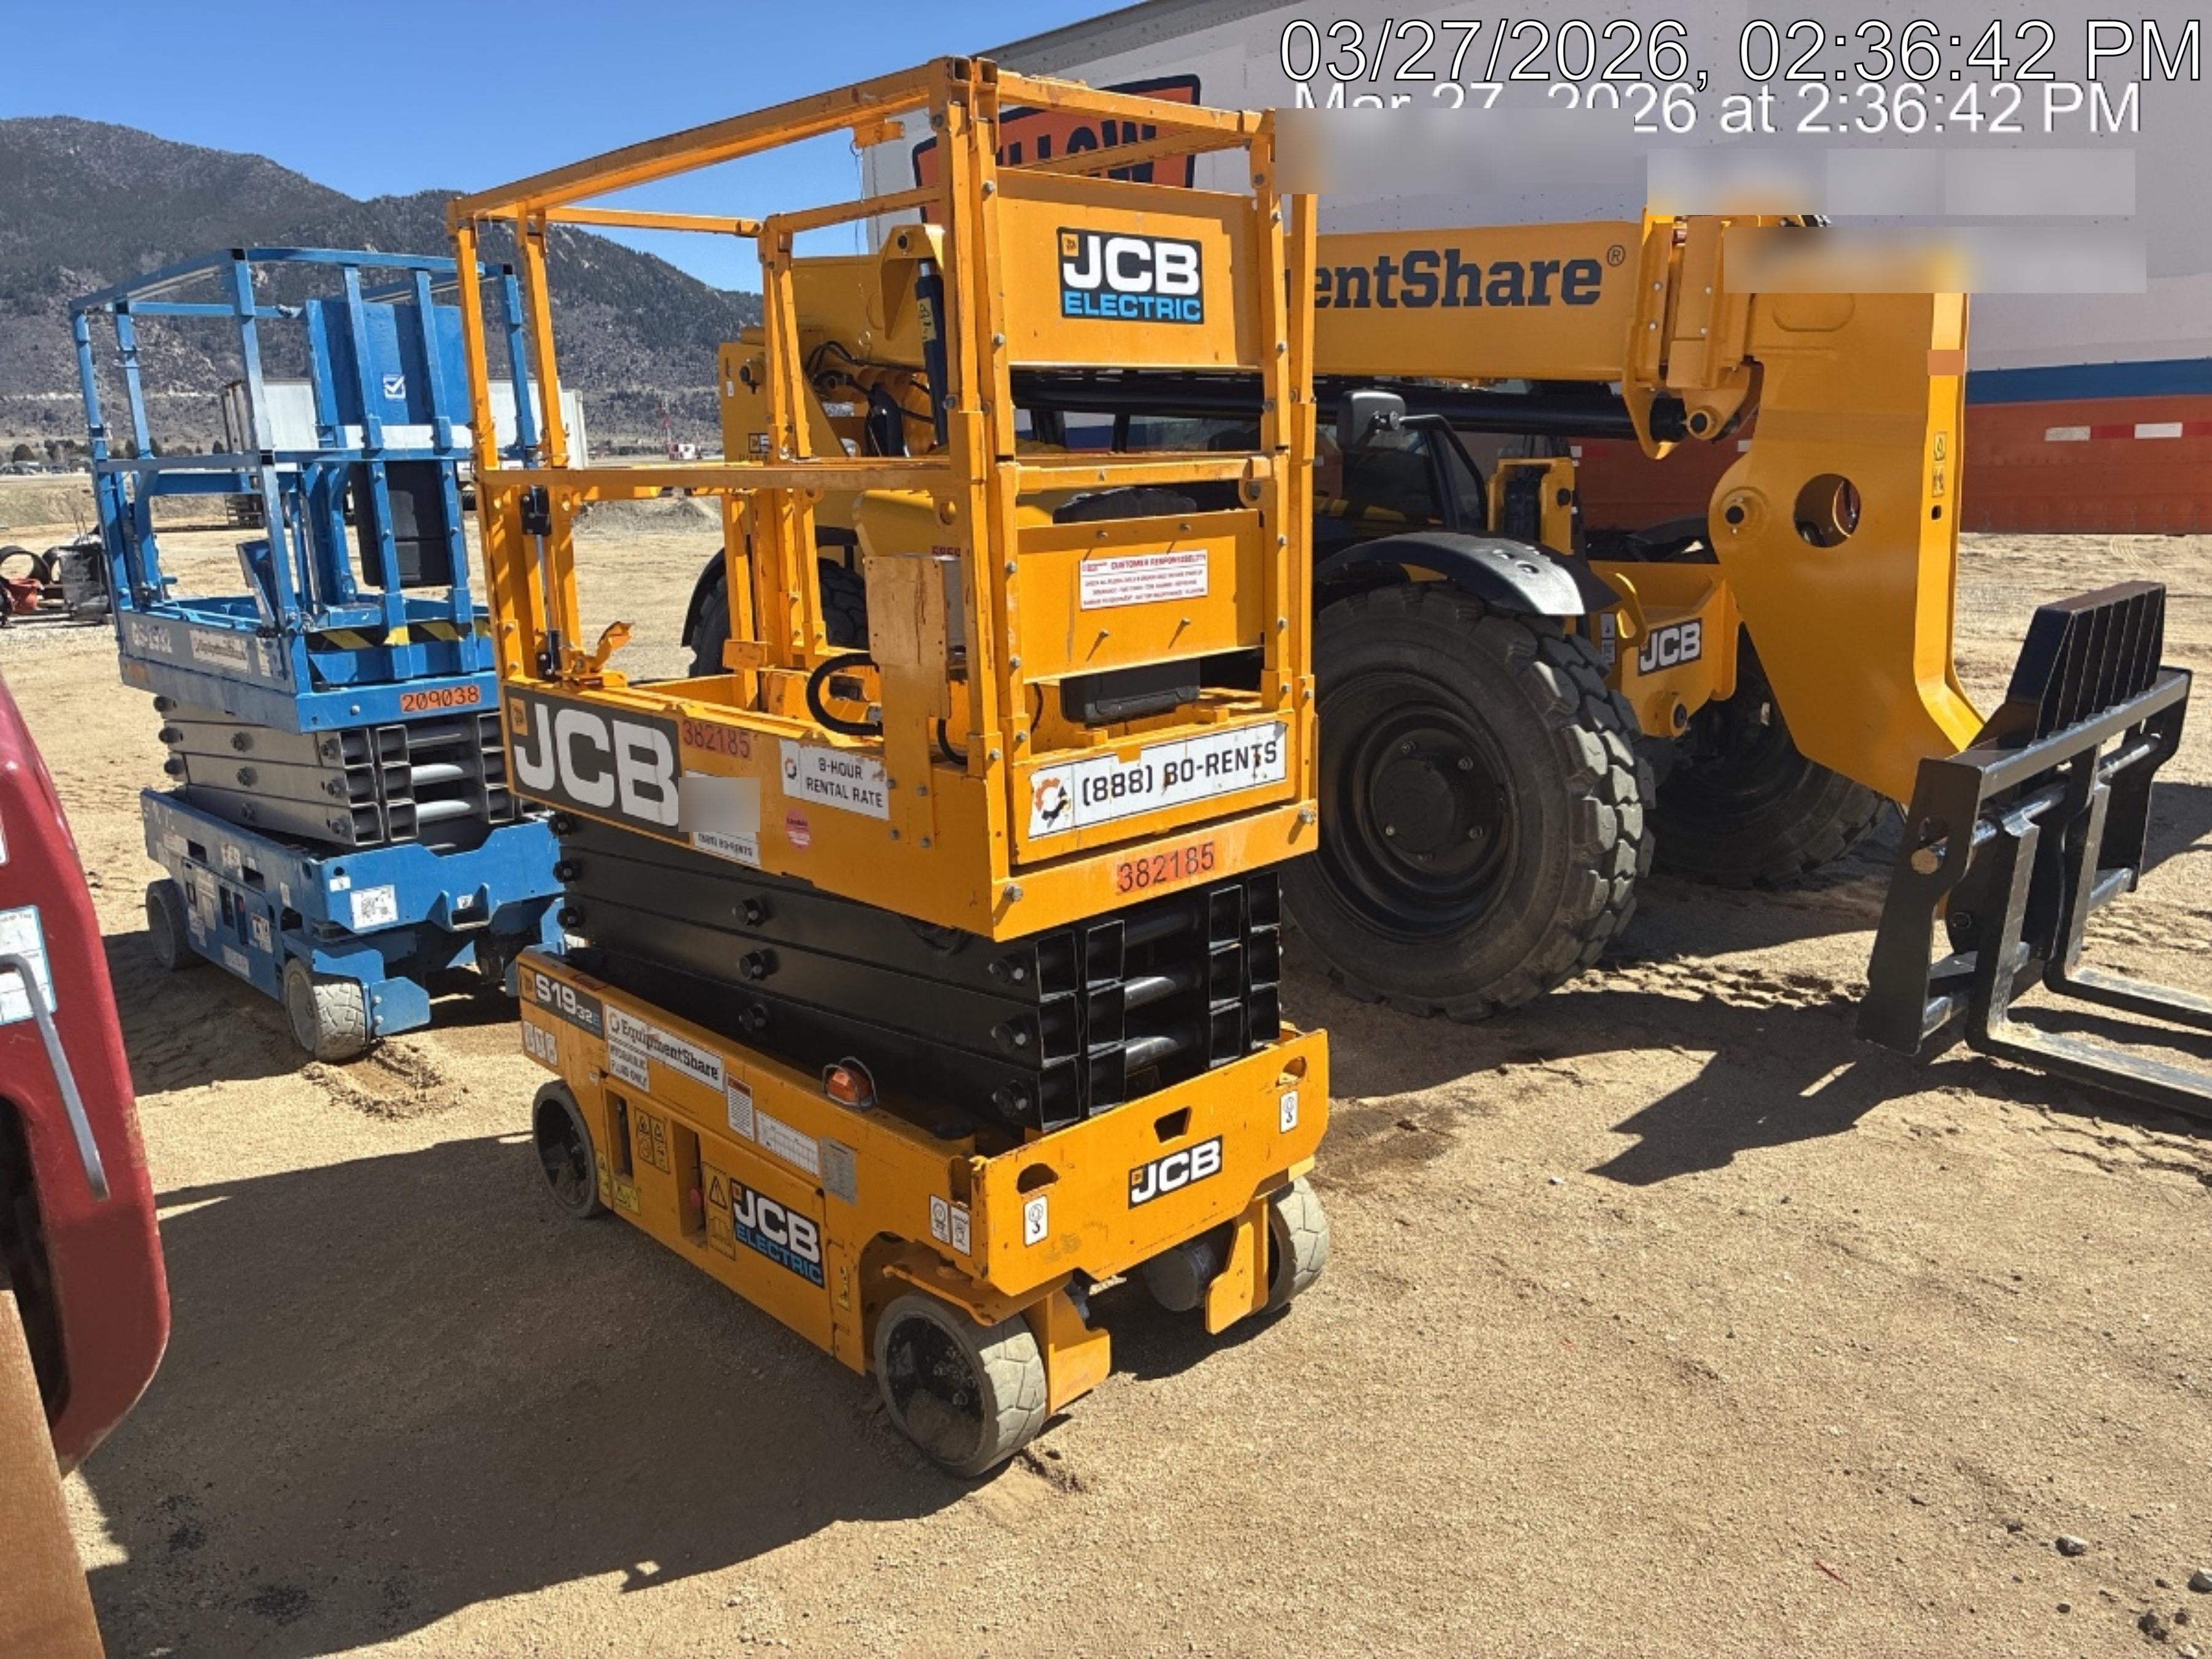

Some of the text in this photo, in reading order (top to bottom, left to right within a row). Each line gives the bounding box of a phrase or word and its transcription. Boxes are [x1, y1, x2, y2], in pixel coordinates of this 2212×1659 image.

[1063, 235, 1201, 295] JCB
[1064, 291, 1201, 321] ELECTRIC
[1639, 622, 1701, 672] JCB
[402, 686, 480, 712] 209038
[514, 702, 679, 826] JCB
[683, 720, 751, 758] 382185
[806, 777, 884, 808] RENTAL RATE
[818, 757, 863, 780] 8-HOUR
[1082, 764, 1153, 806] (888)
[1118, 842, 1215, 893] 382185
[621, 1019, 718, 1081] EquipmentShare
[1131, 1140, 1222, 1206] JCB
[734, 1189, 820, 1264] JCB
[735, 1222, 824, 1284] ELECTRIC
